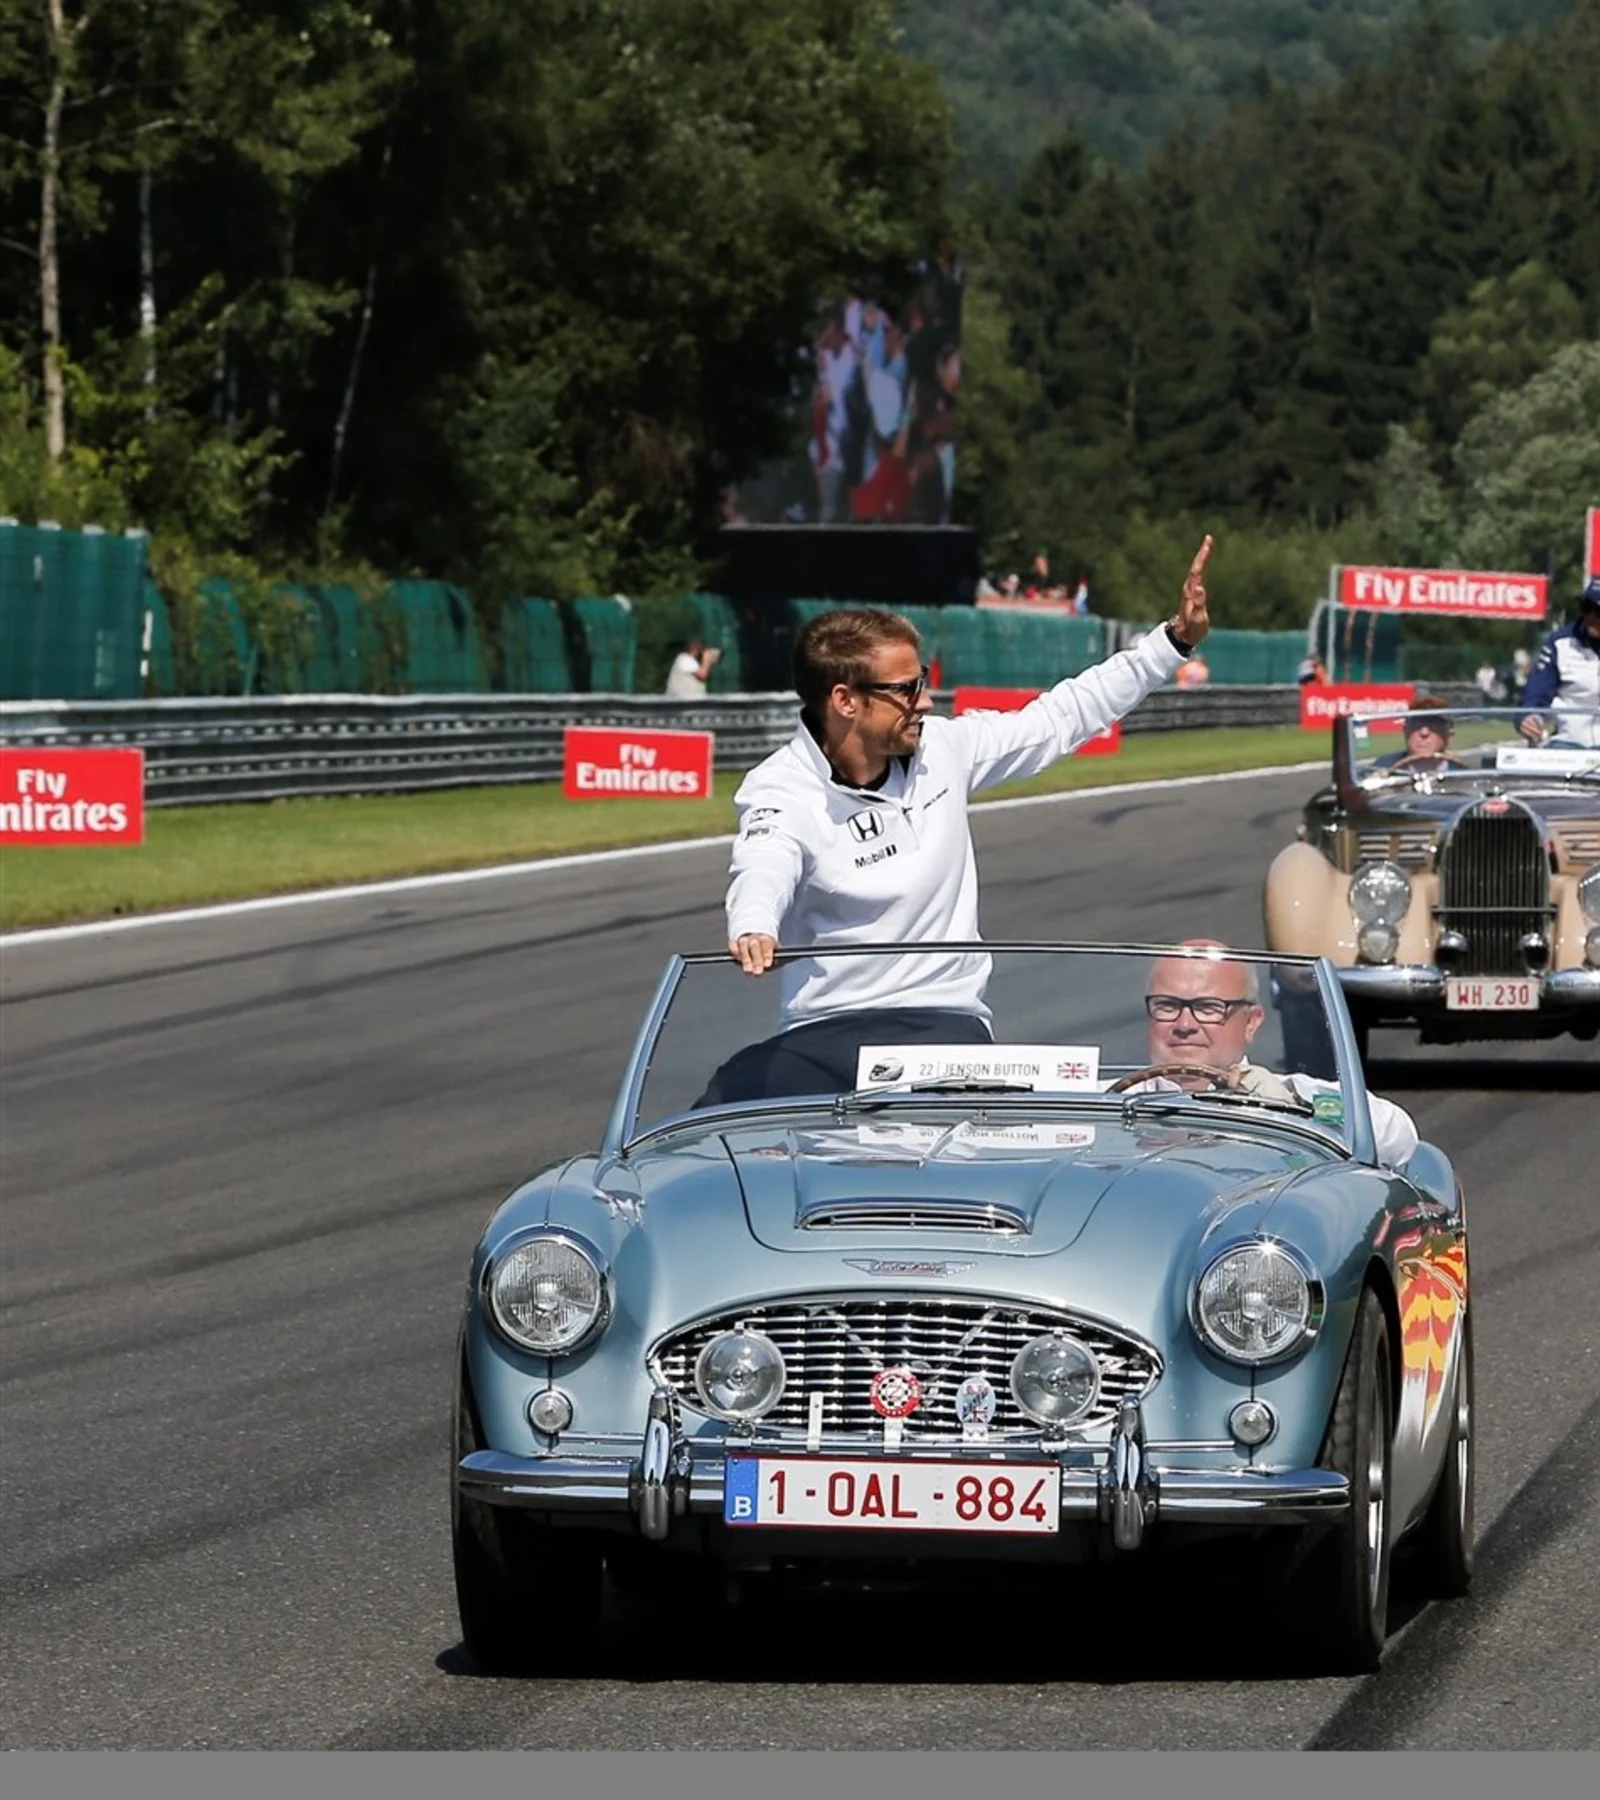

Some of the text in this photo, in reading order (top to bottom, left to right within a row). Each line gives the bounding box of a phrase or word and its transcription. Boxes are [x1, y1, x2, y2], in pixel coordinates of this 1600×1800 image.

[1354, 572, 1538, 610] Fly Emirates
[1306, 696, 1337, 718] Fly
[619, 743, 657, 768] Fly
[16, 768, 67, 799] Fly
[576, 761, 699, 793] Emirates
[0, 795, 128, 832] mirates
[918, 1063, 1041, 1077] 22 JENSON BUTTON
[733, 1469, 1047, 1523] B 1-OAL-884
